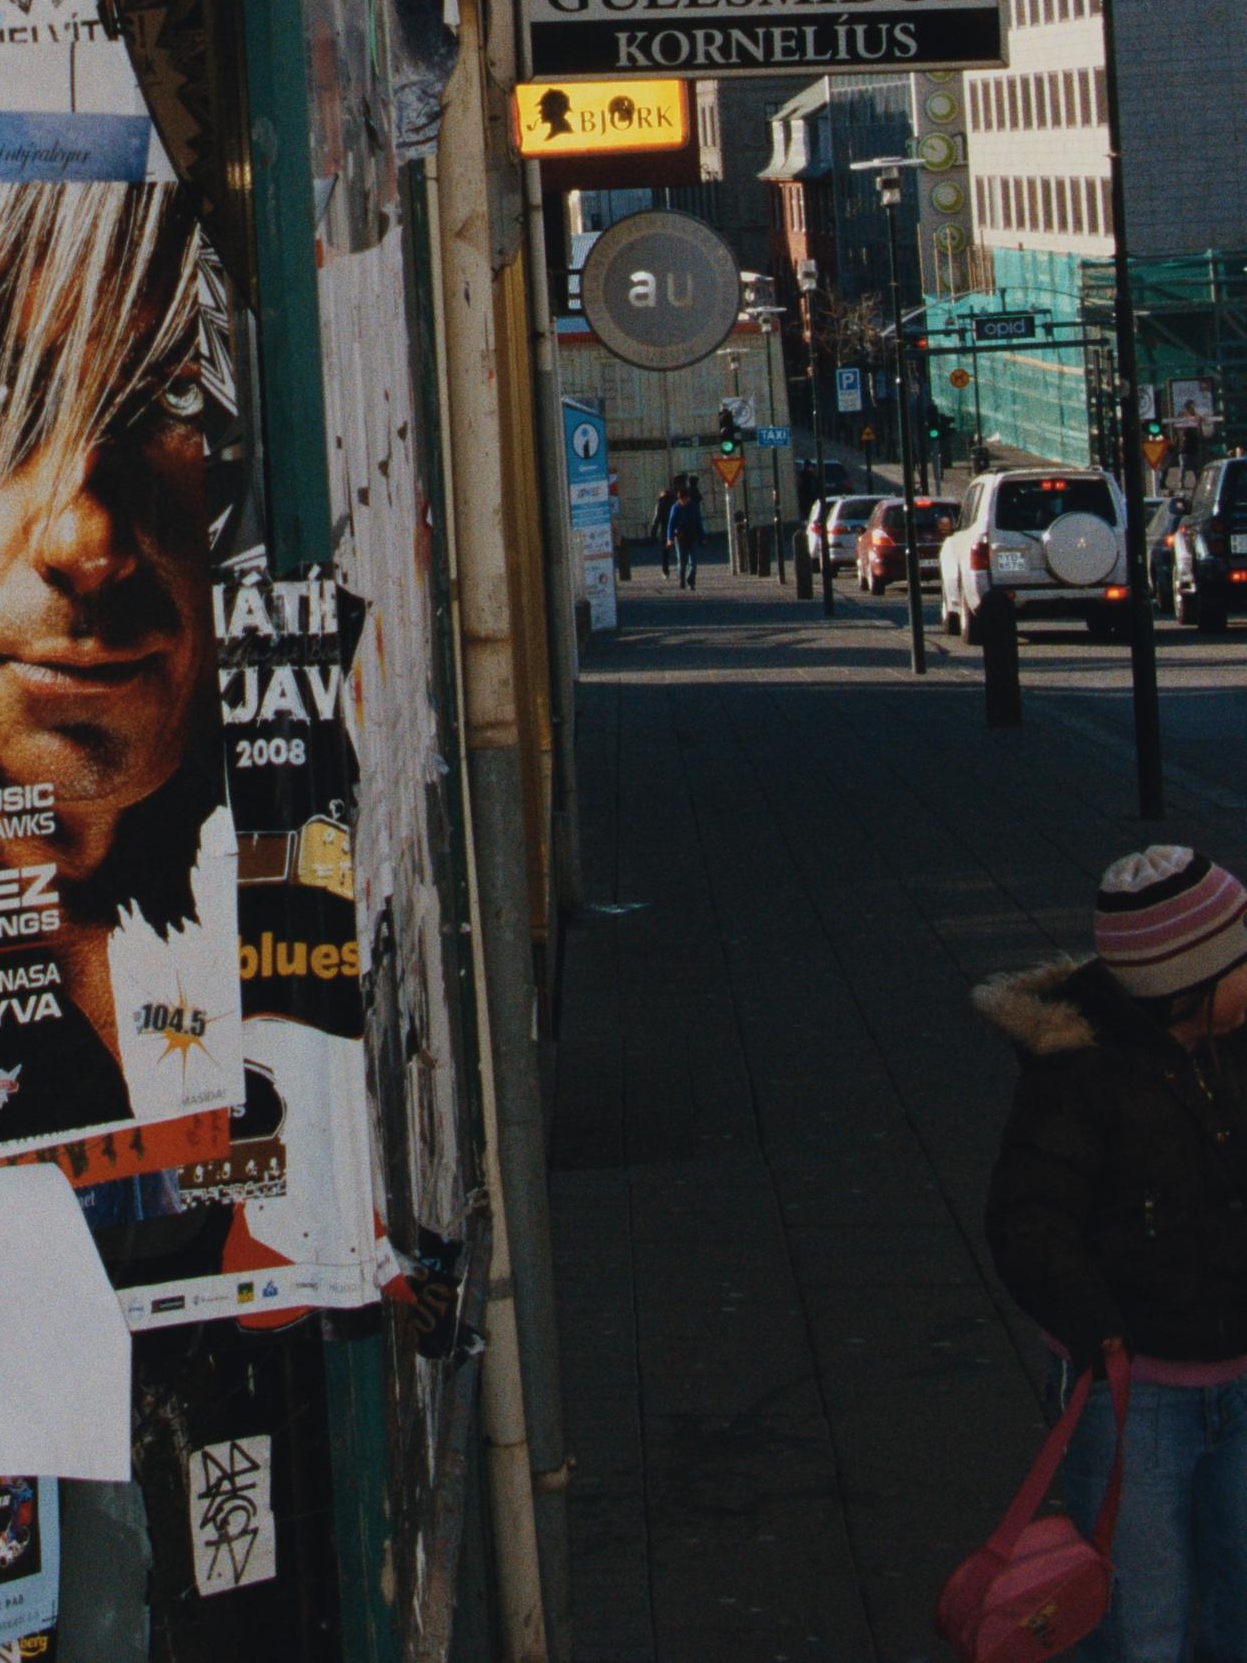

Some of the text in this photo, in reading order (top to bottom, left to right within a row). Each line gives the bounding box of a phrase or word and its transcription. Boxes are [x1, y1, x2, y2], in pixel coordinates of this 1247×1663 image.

[616, 15, 918, 68] KORNELÍUS
[841, 373, 854, 389] P
[760, 430, 786, 439] TAXI
[237, 739, 306, 767] 2008
[140, 1002, 206, 1037] 104.5
